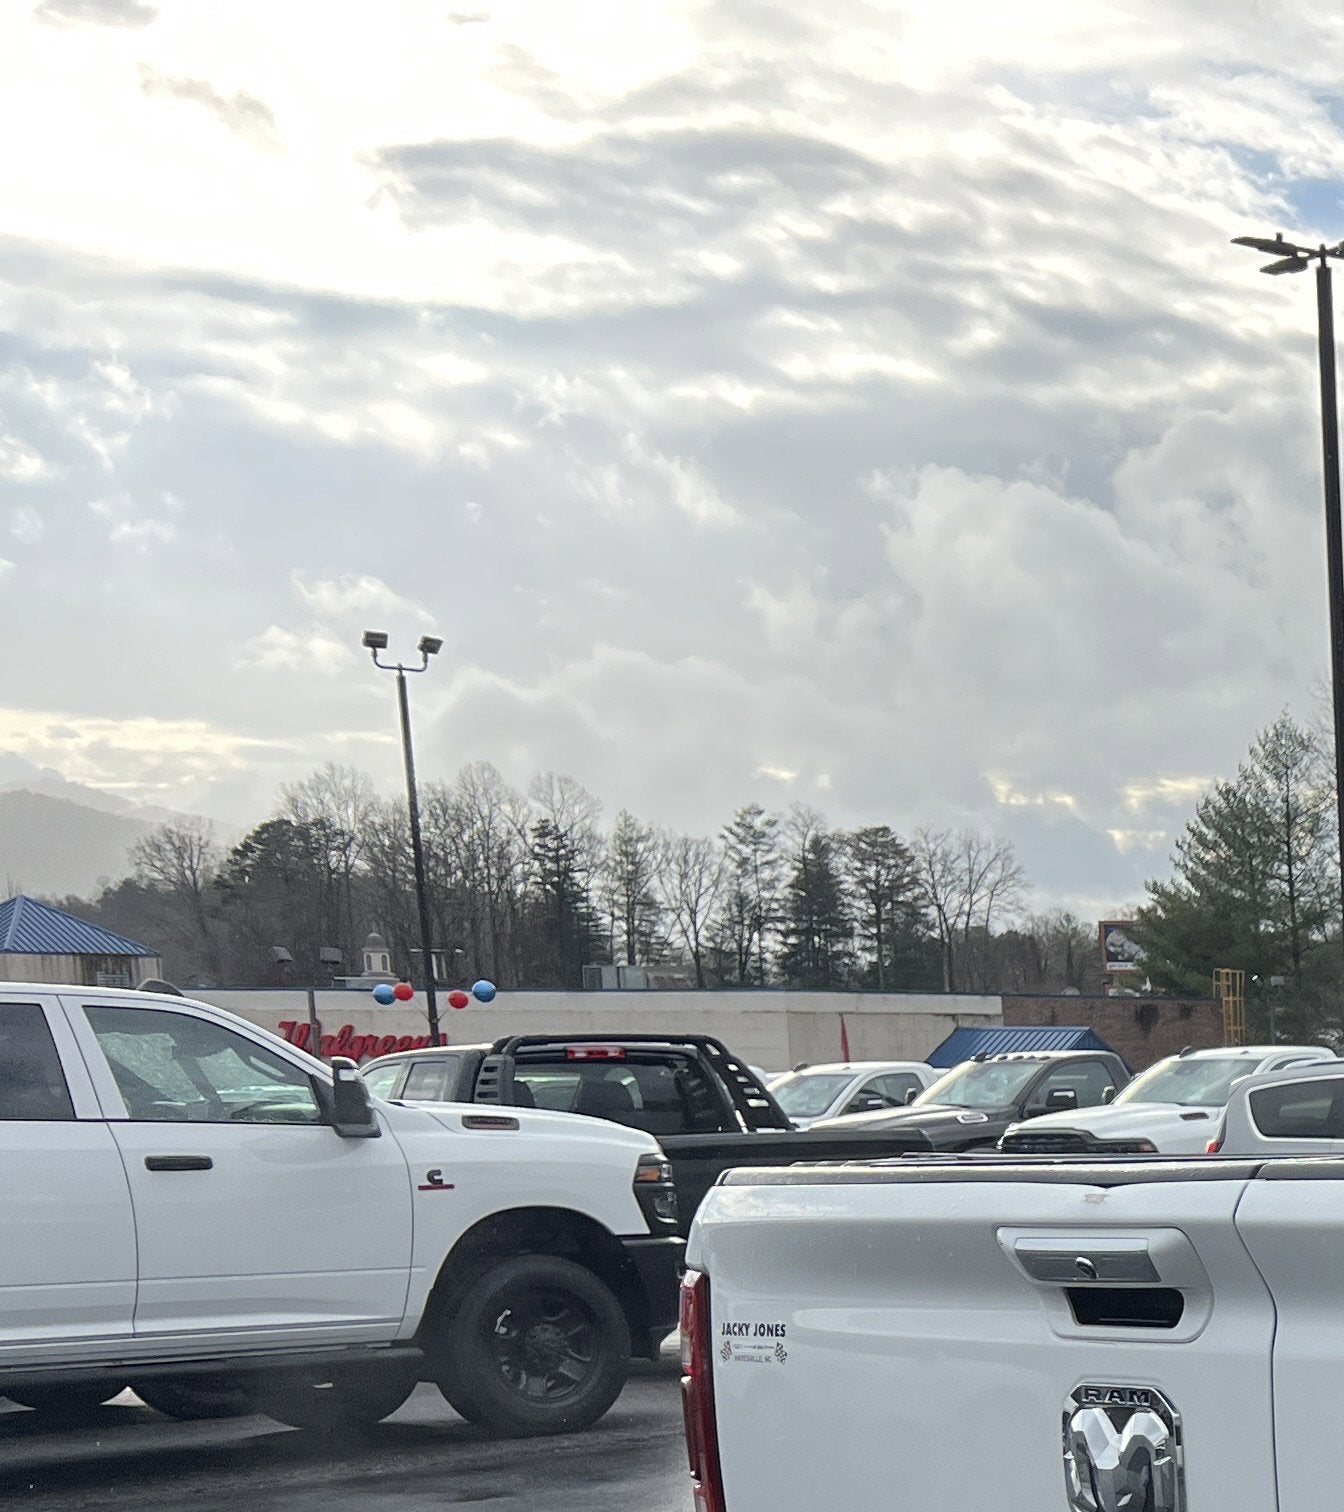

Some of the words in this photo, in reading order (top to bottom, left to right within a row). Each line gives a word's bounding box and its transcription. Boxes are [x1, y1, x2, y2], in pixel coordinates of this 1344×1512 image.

[721, 1322, 750, 1337] JACKY
[753, 1323, 786, 1338] JONES
[1082, 1387, 1151, 1406] RAM
